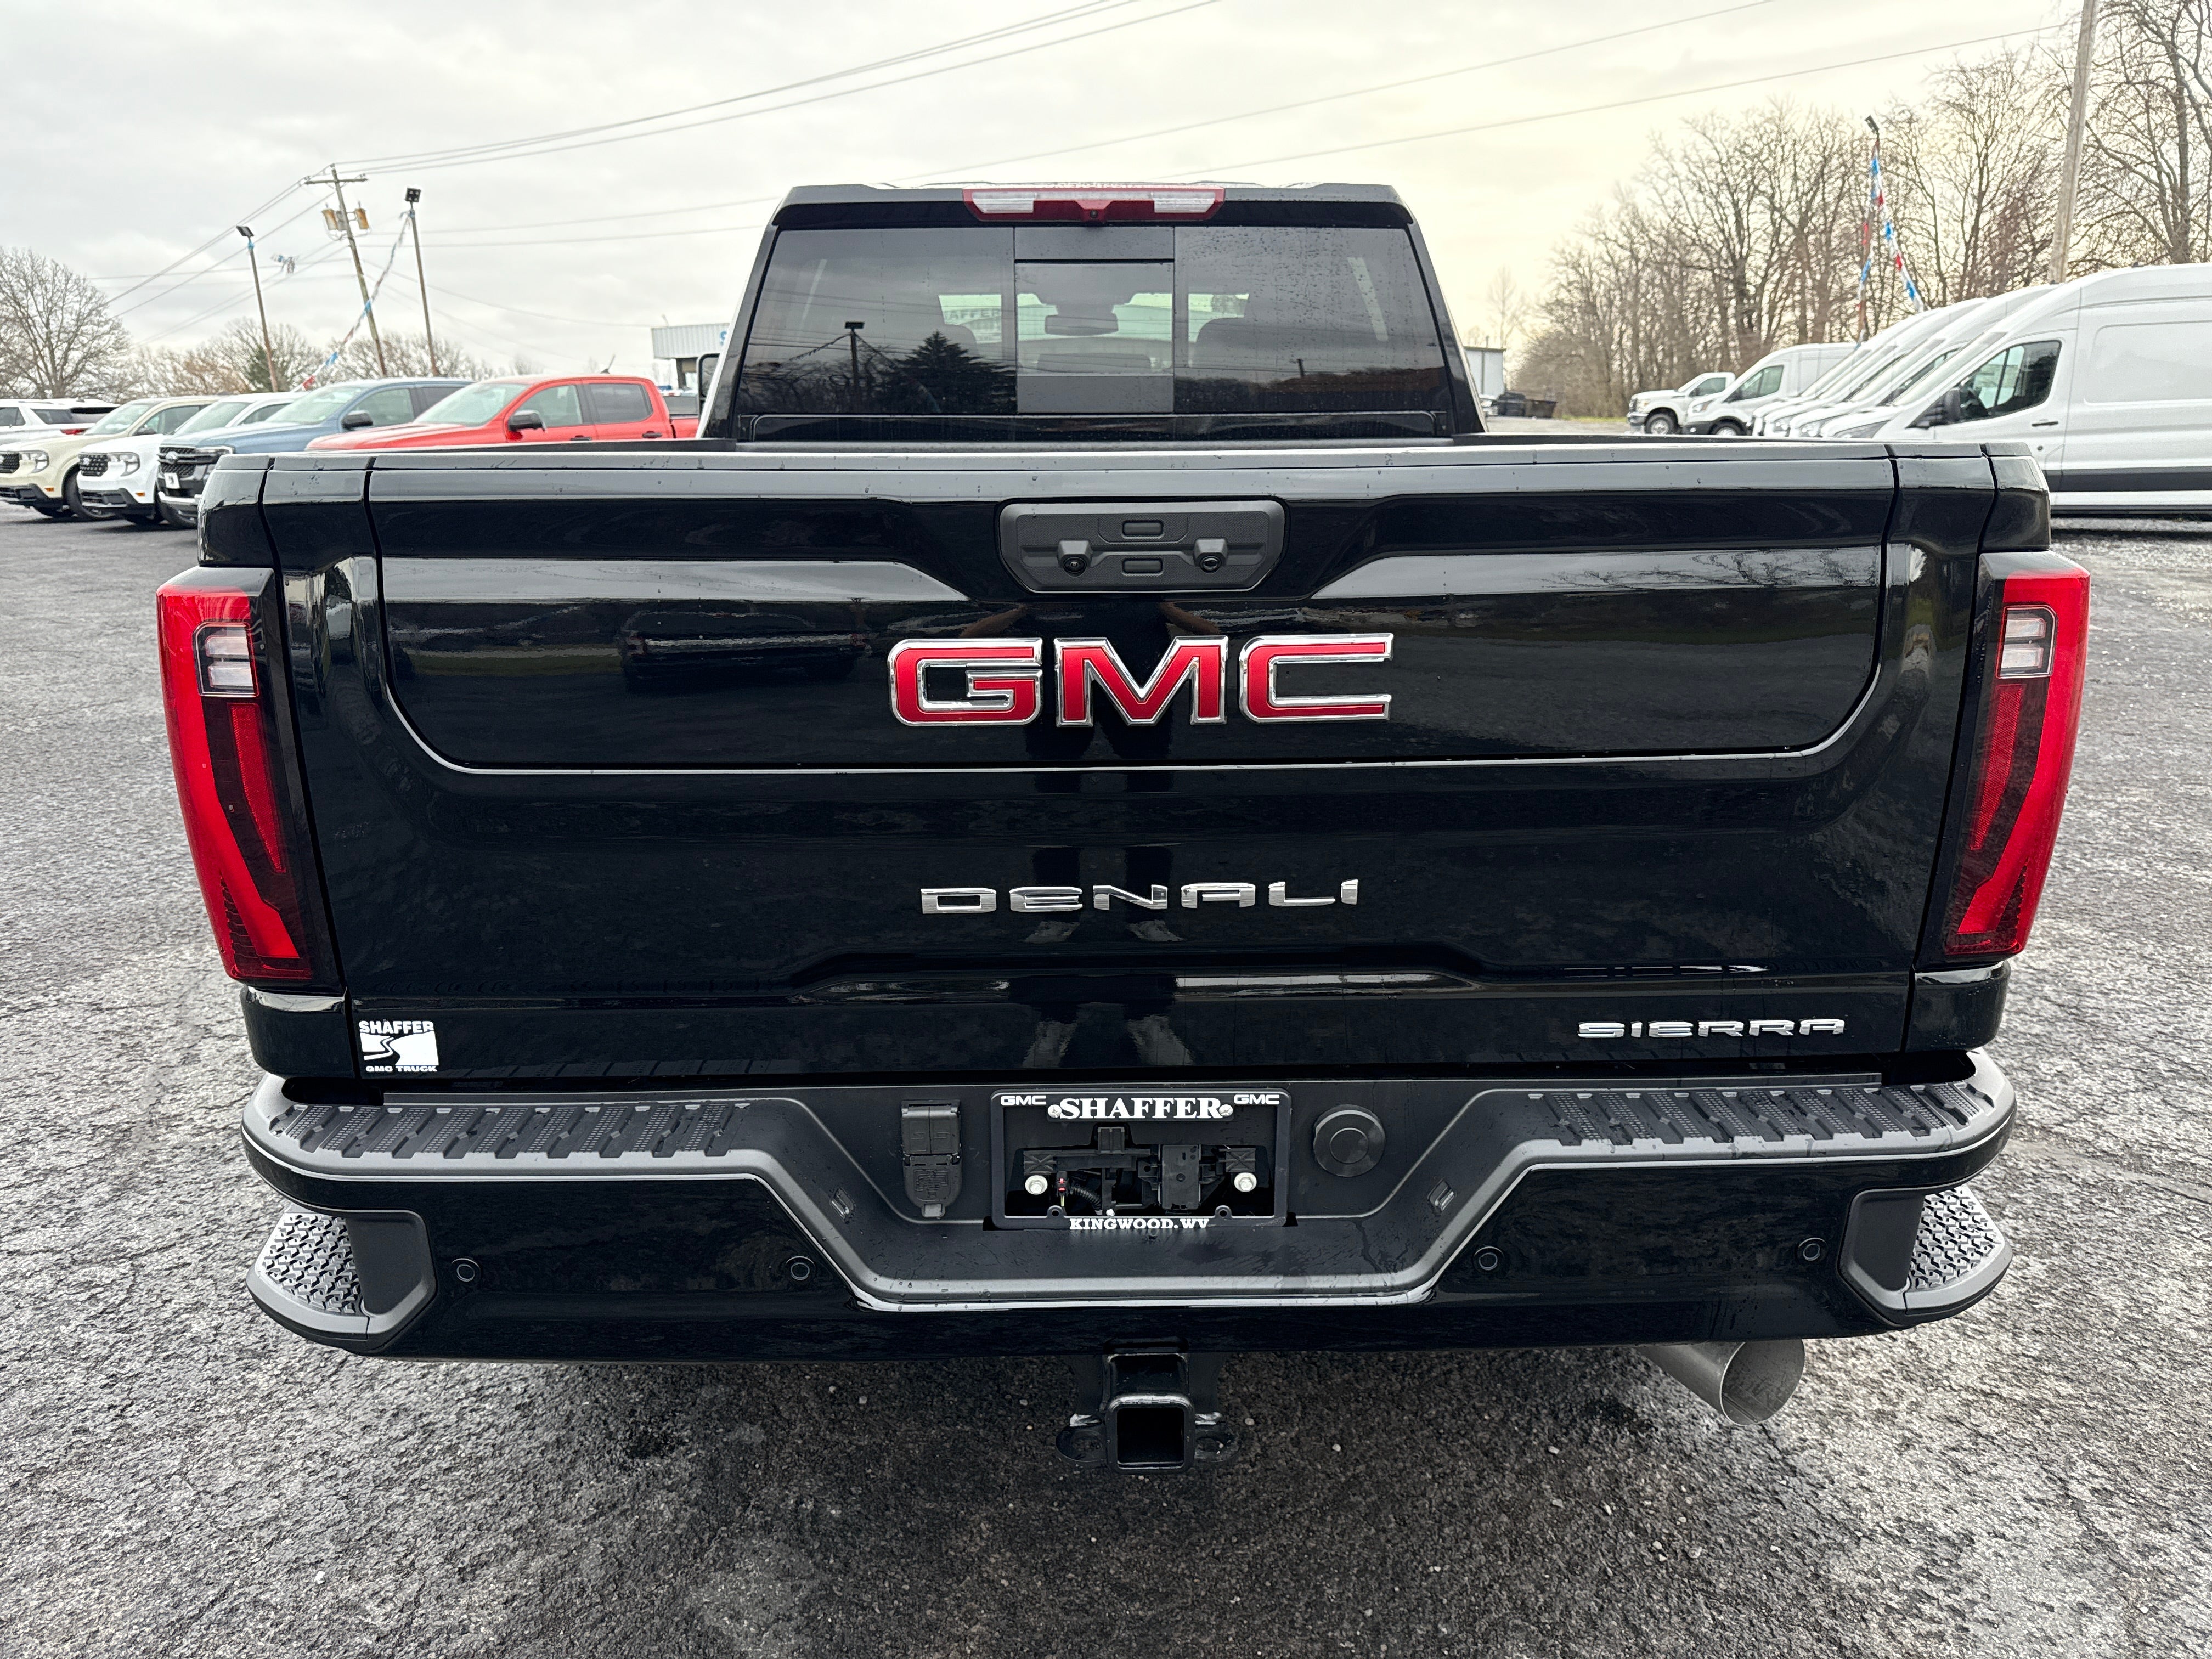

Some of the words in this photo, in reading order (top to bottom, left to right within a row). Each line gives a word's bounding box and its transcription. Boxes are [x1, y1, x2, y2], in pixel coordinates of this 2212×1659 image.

[887, 633, 1394, 727] GMC
[921, 879, 1359, 914] DENALI
[358, 1020, 434, 1034] SHAFFER
[1578, 1019, 1845, 1038] SIERRA
[1000, 1095, 1046, 1105] GMC
[1060, 1098, 1223, 1119] SHAFFER
[1234, 1094, 1280, 1104] GMC
